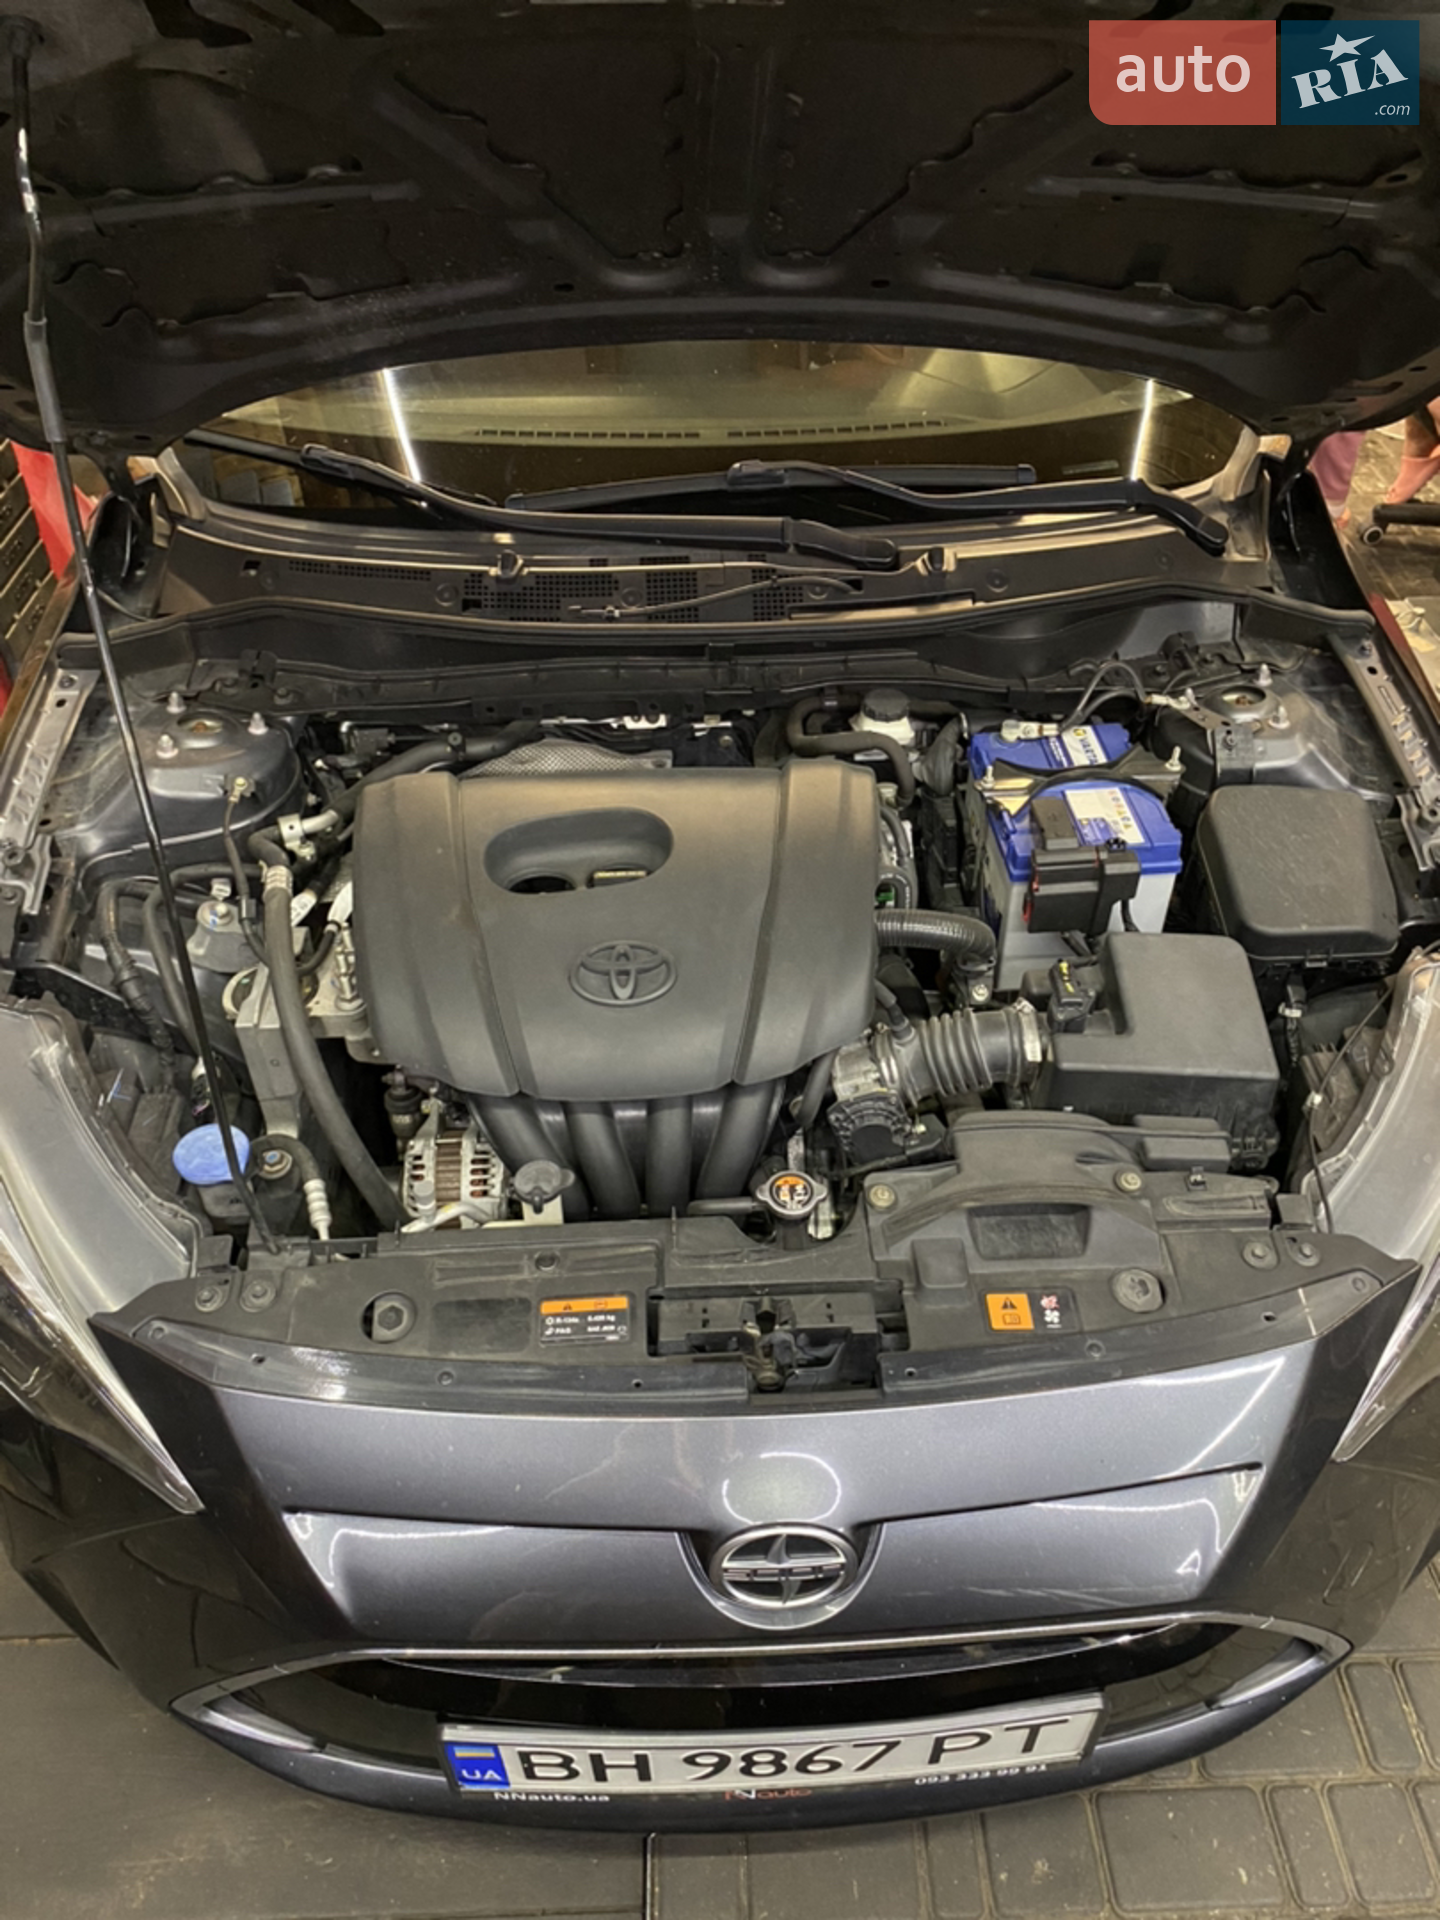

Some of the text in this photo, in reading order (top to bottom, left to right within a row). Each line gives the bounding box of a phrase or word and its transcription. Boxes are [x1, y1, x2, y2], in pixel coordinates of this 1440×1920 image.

[517, 1718, 1070, 1783] BH 9867 PT
[461, 1769, 502, 1781] UA
[915, 1774, 950, 1786] 093
[494, 1791, 610, 1802] NNauto.ua
